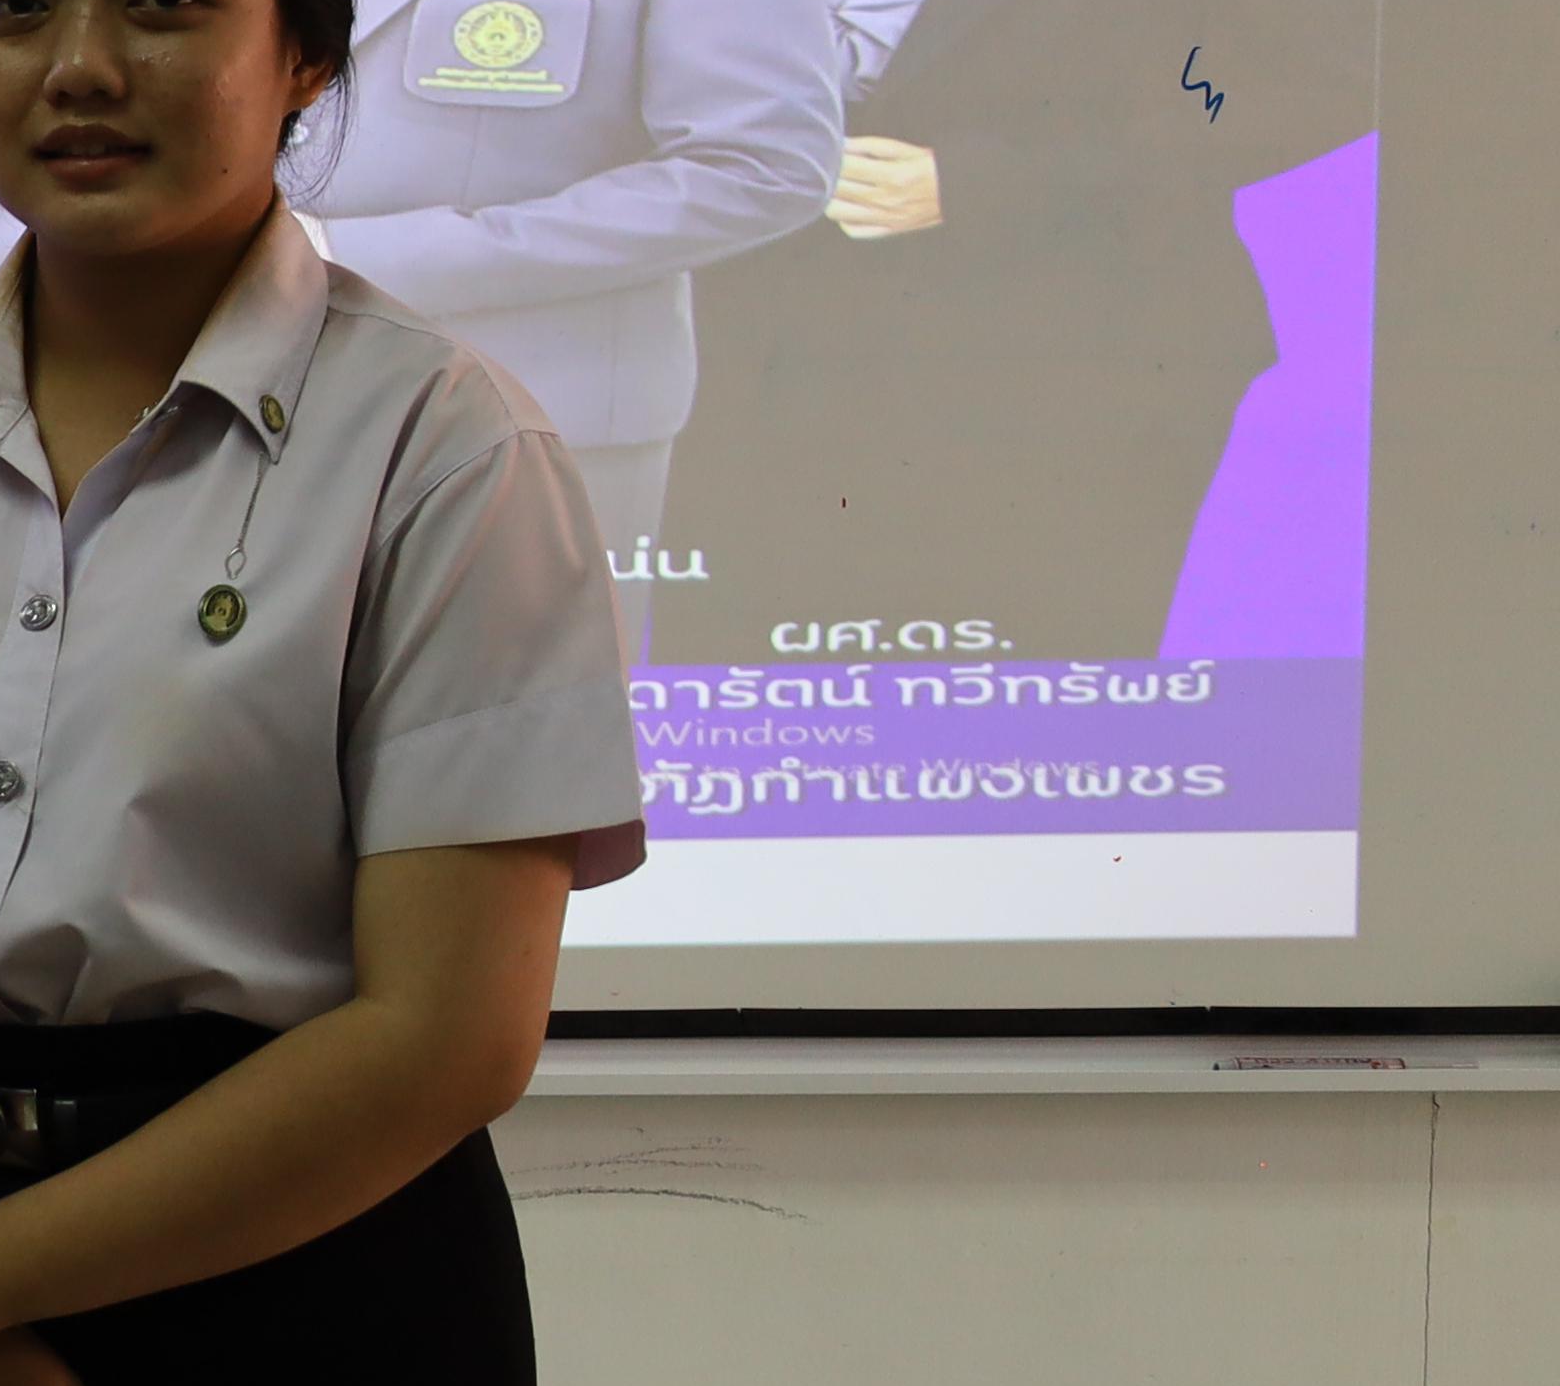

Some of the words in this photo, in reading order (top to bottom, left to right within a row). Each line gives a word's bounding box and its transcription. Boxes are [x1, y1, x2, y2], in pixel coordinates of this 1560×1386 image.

[771, 618, 1014, 653] ผศ.ดร.
[895, 659, 1216, 707] ทวีทรัพย์
[638, 718, 876, 746] Windows
